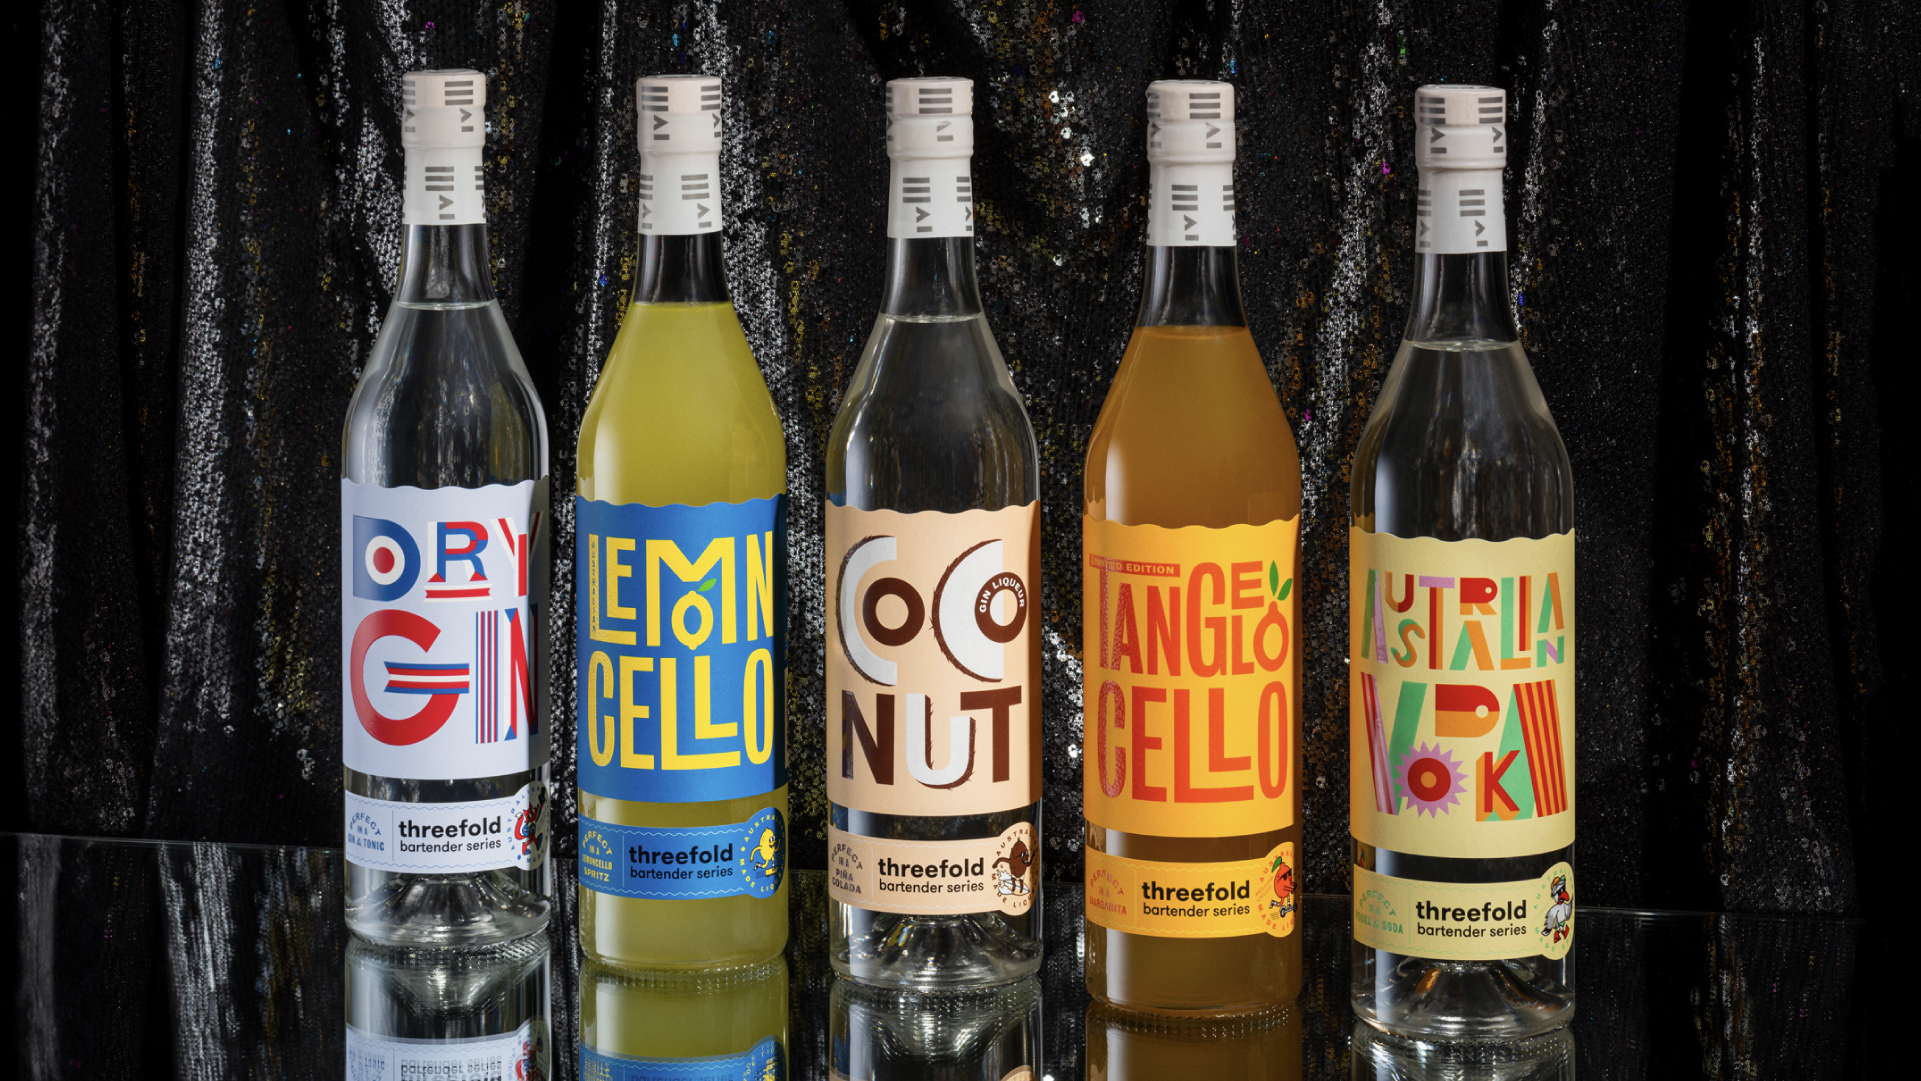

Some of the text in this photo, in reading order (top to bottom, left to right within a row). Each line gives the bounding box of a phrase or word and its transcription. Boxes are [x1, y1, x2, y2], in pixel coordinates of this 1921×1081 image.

[353, 511, 544, 602] DRY
[1126, 563, 1174, 574] EDITION
[979, 576, 1025, 613] GIN LIQUEUR
[835, 534, 1027, 687] COCO
[1089, 553, 1289, 678] TANGELO
[350, 603, 538, 746] GIN
[588, 648, 774, 770] CELLO
[842, 685, 1022, 790] NUT
[1098, 680, 1288, 803] CELLO
[1361, 671, 1568, 822] VODKA
[349, 812, 382, 836] PERFECT
[399, 816, 501, 838] threefold
[356, 837, 362, 847] &
[363, 838, 385, 852] TONIC
[400, 838, 501, 853] bartender series
[582, 830, 613, 855] PERFECT
[629, 843, 733, 864] threefold
[831, 843, 864, 870] PERFECT
[584, 866, 610, 882] SPRITZ
[630, 866, 733, 879] bartender series
[836, 868, 854, 882] PIÑA
[878, 858, 984, 878] threefold
[832, 876, 862, 894] COLADA
[879, 879, 984, 893] bartender series
[1090, 870, 1124, 896] PERFECT
[1142, 880, 1250, 902] threefold
[1090, 896, 1127, 916] MARGARITA
[1144, 903, 1250, 917] bartender series
[1359, 890, 1396, 916] PERFECT
[1416, 900, 1526, 922] threefold
[1373, 919, 1380, 929] &
[1382, 920, 1404, 934] SODA
[1417, 922, 1526, 938] bartender series
